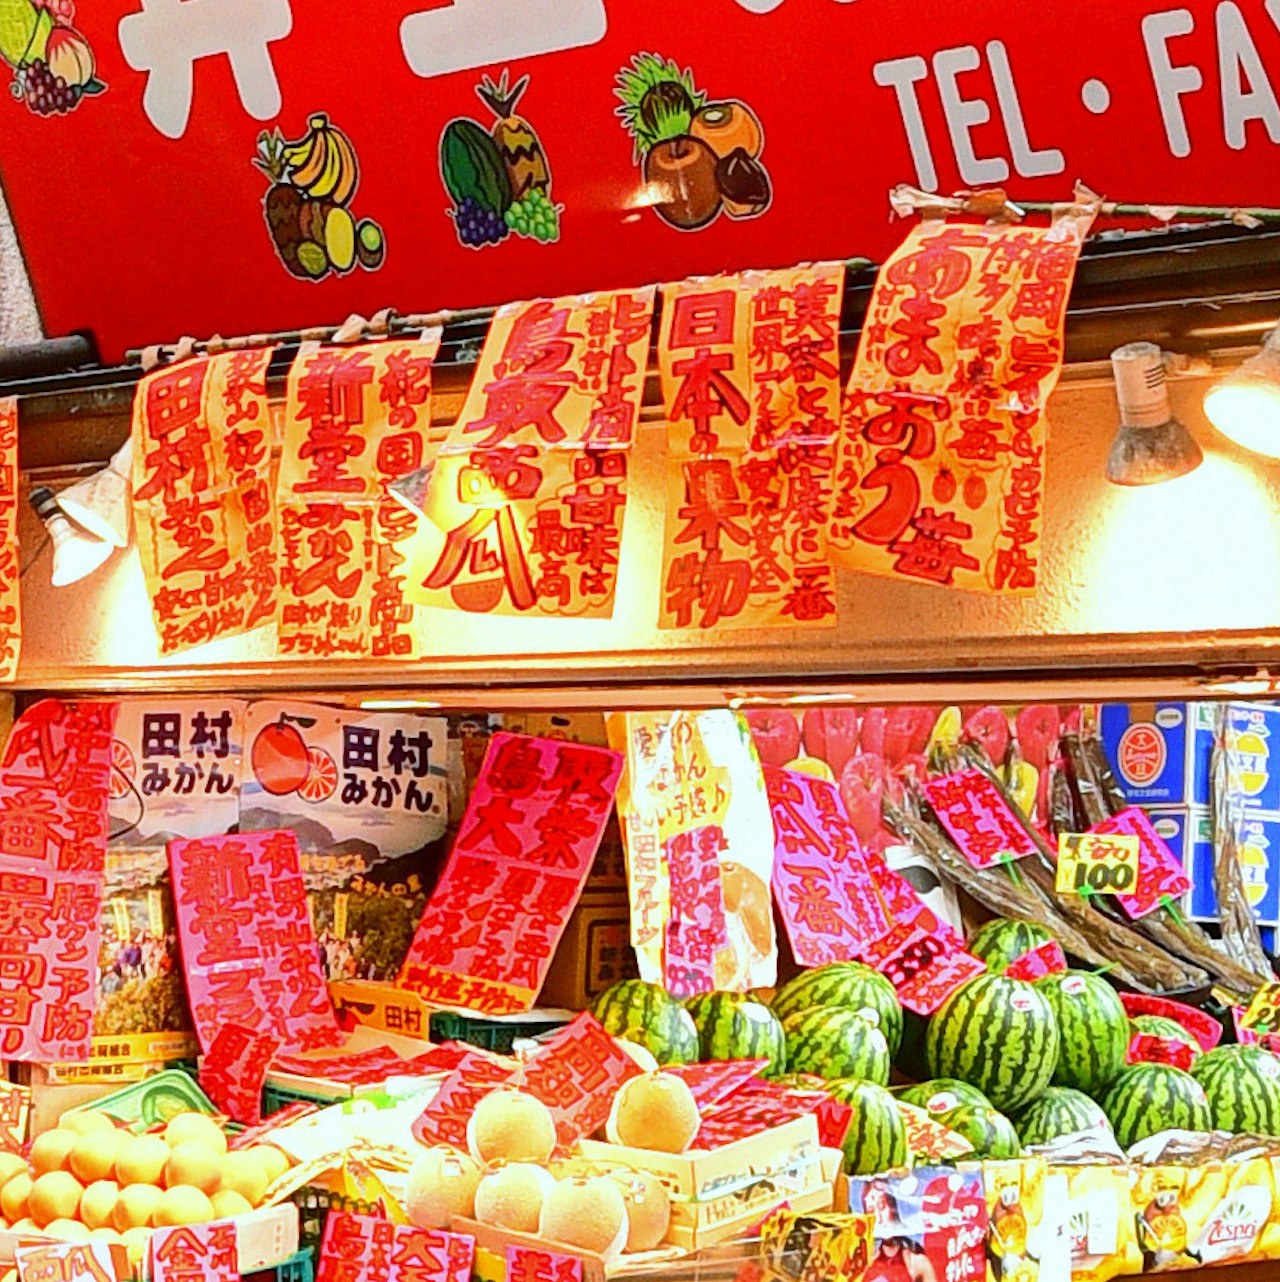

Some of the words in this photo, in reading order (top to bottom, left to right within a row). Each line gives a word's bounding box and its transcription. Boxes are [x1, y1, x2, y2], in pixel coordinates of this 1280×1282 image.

[875, 40, 1065, 192] TEL
[140, 711, 232, 759] 田村
[341, 725, 432, 777] 田村
[141, 761, 235, 796] みかん
[341, 773, 433, 813] みかん
[1073, 862, 1134, 892] 100
[1207, 1215, 1260, 1246] Zespri
